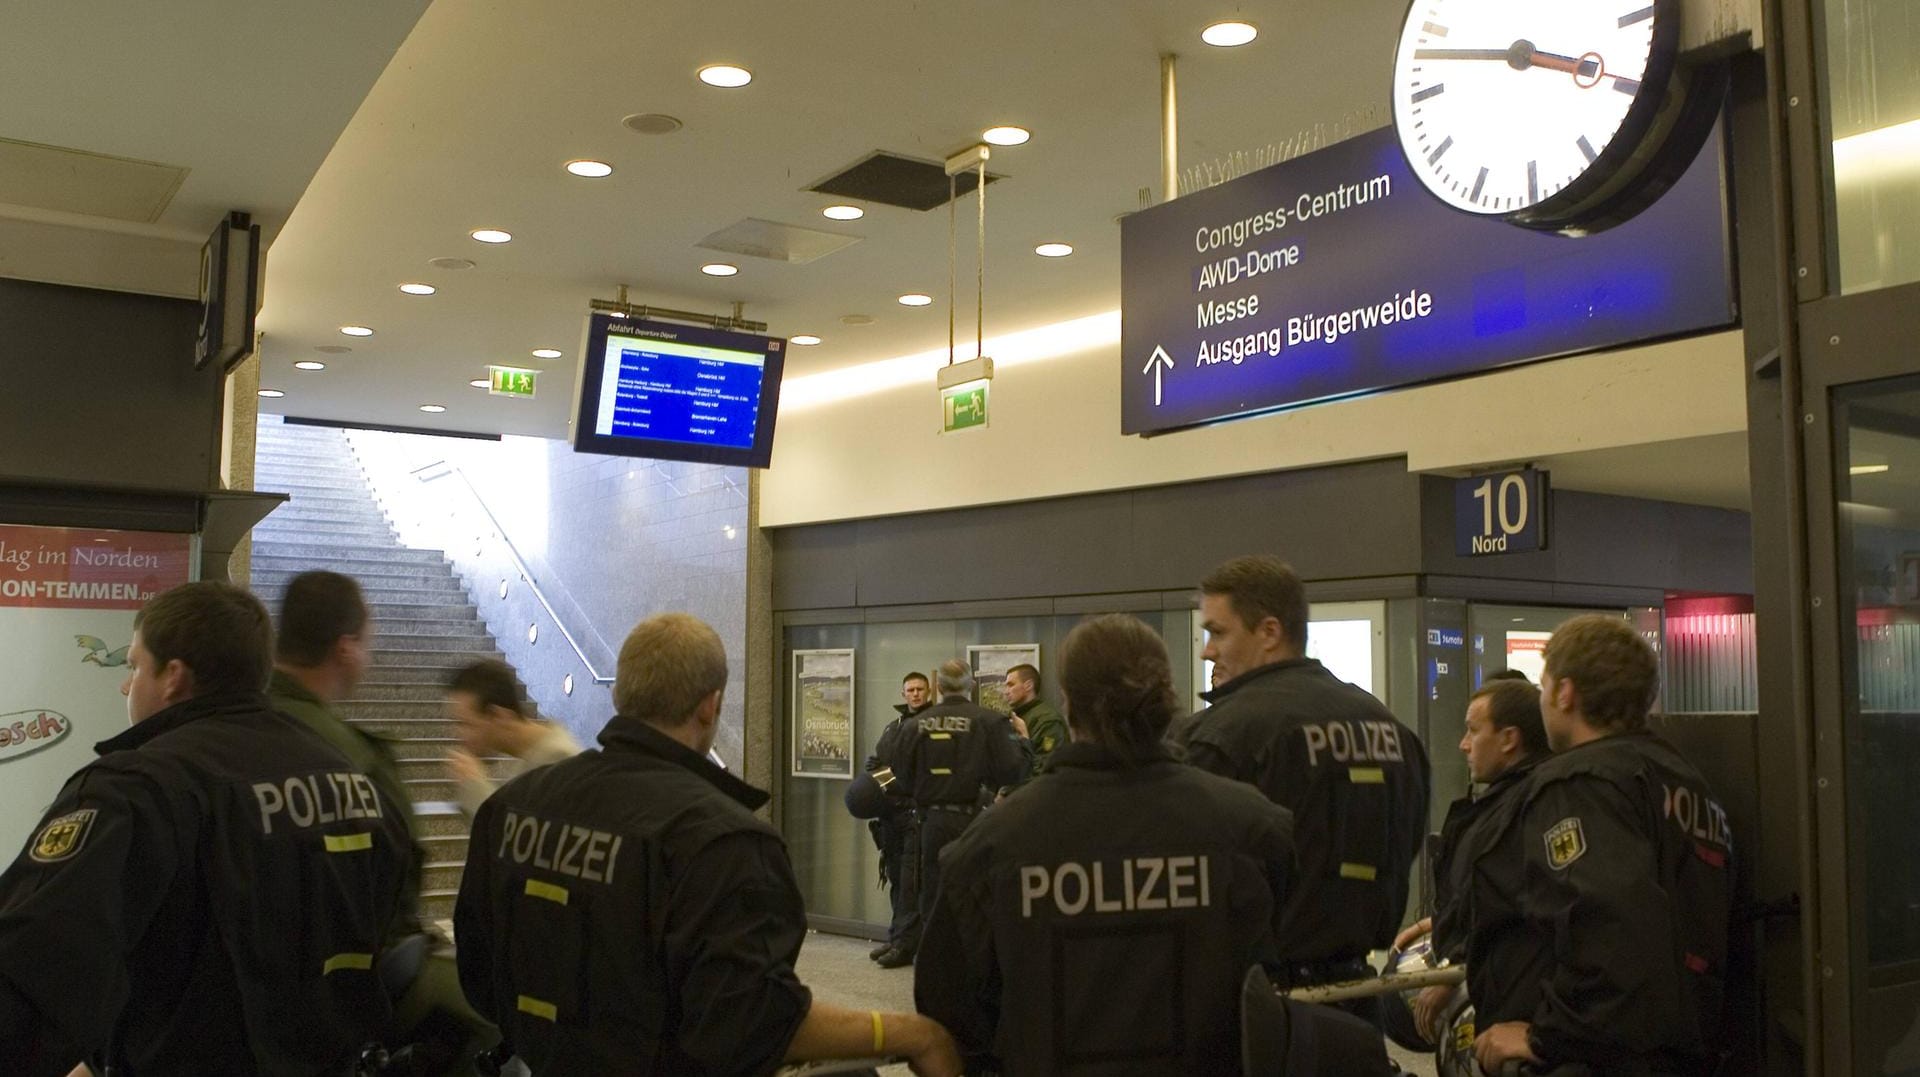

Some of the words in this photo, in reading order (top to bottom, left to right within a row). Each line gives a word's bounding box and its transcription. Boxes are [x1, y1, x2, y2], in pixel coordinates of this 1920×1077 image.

[1196, 174, 1390, 253] Congress-Centrum
[1198, 244, 1299, 291] AWD-Dome
[607, 322, 634, 334] Abfahrt
[1196, 327, 1281, 367] Ausgang
[1287, 290, 1432, 346] Bürgerweide
[1197, 294, 1259, 329] Messe
[1473, 474, 1528, 536] 10
[38, 544, 67, 565] im
[75, 546, 160, 569] Norden
[1472, 533, 1507, 554] Nord
[0, 580, 156, 601] ON-TEMMEN.DE
[918, 716, 971, 733] POLIZEI
[1302, 720, 1404, 767] POLIZEI
[252, 772, 384, 834] POLIZEI
[498, 812, 623, 885] POLIZEI
[1020, 855, 1211, 918] POLIZEI
